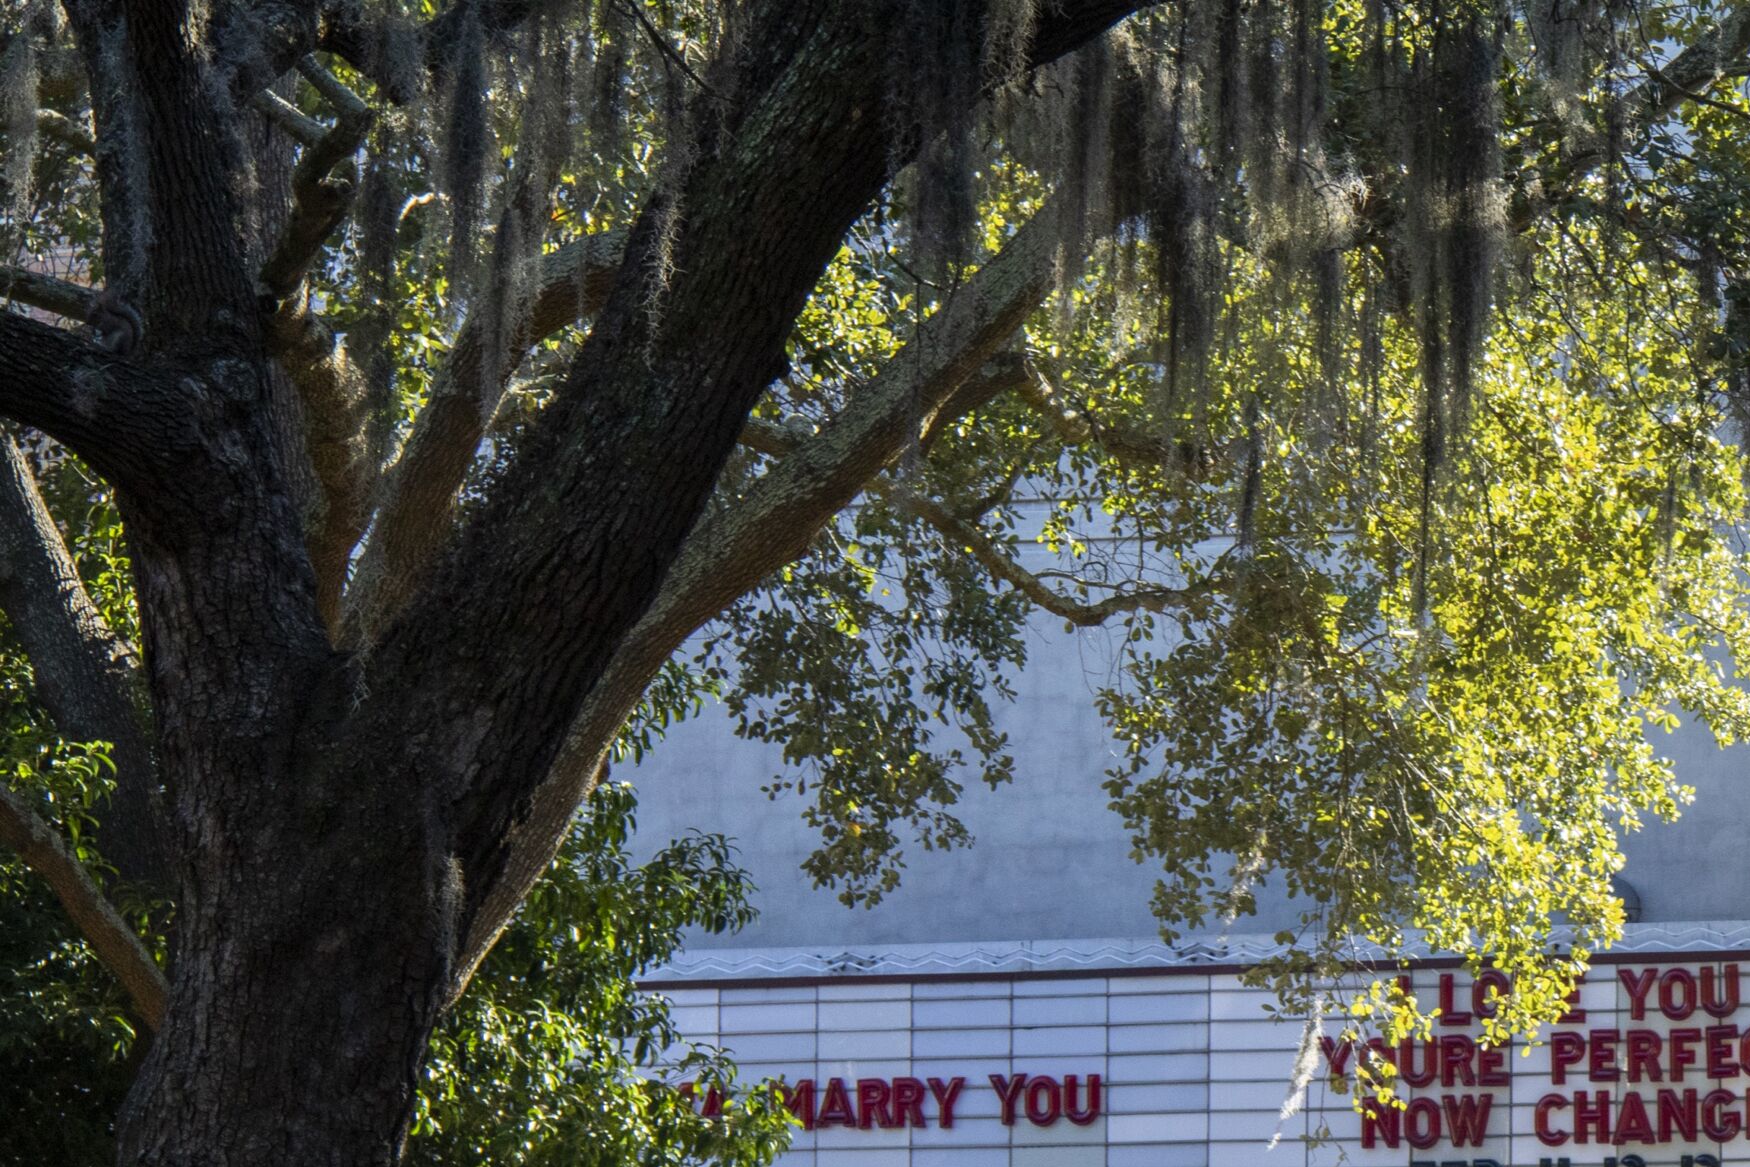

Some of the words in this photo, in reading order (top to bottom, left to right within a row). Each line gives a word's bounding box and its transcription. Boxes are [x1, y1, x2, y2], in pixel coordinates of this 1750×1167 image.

[1439, 969, 1588, 1026] LOE
[1617, 963, 1741, 1021] YOU
[1318, 1033, 1511, 1089] YOURE
[768, 1076, 966, 1131] MARRY
[988, 1072, 1102, 1128] YOU
[1361, 1093, 1493, 1149] NOW
